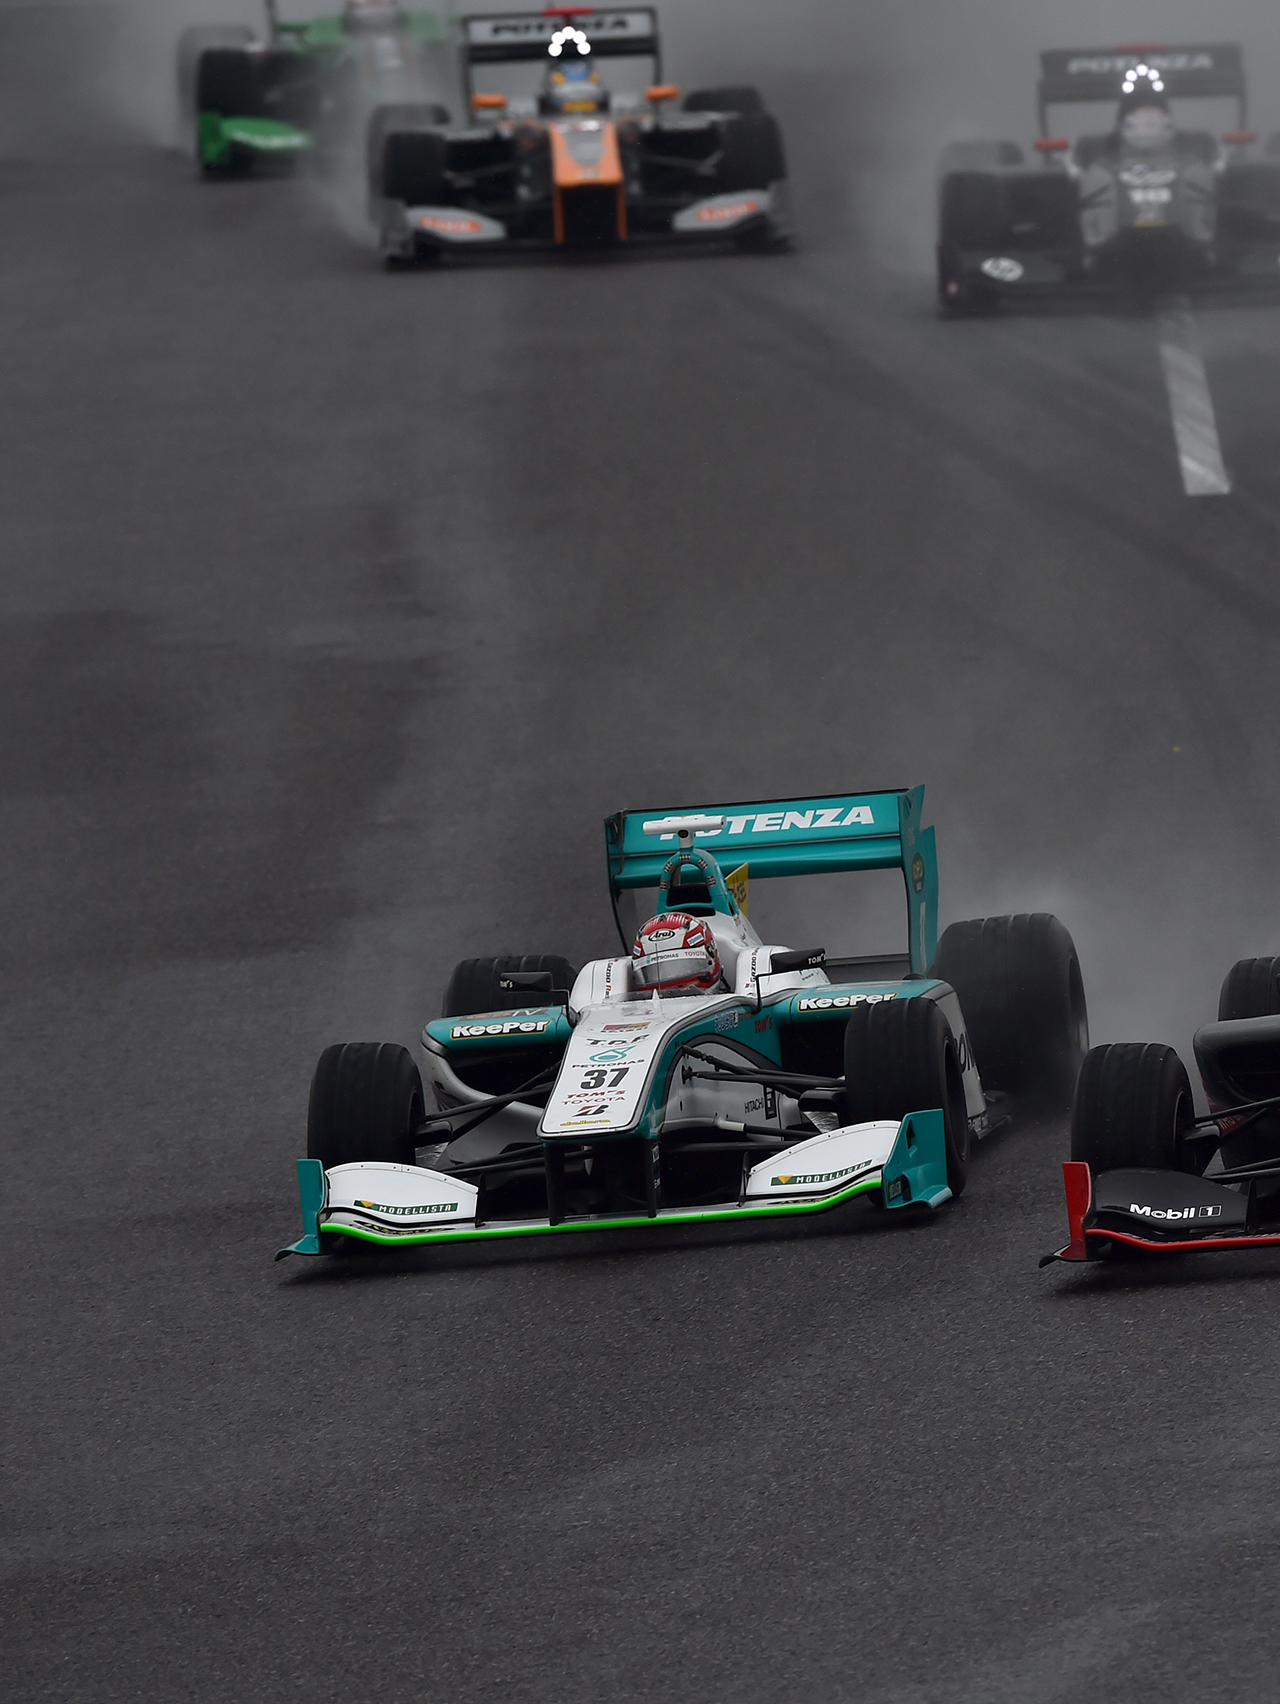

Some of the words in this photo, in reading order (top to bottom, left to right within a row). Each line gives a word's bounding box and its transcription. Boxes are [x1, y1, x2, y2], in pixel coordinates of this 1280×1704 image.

[659, 805, 875, 841] TENZA
[453, 1021, 550, 1037] KeePer
[572, 1059, 645, 1069] PETRONAS
[580, 1067, 630, 1090] 37
[562, 1097, 626, 1106] TOYOTA
[796, 1162, 867, 1184] MODELLISTA
[379, 1203, 452, 1215] MODELLISTA
[1129, 1203, 1196, 1220] Mobil
